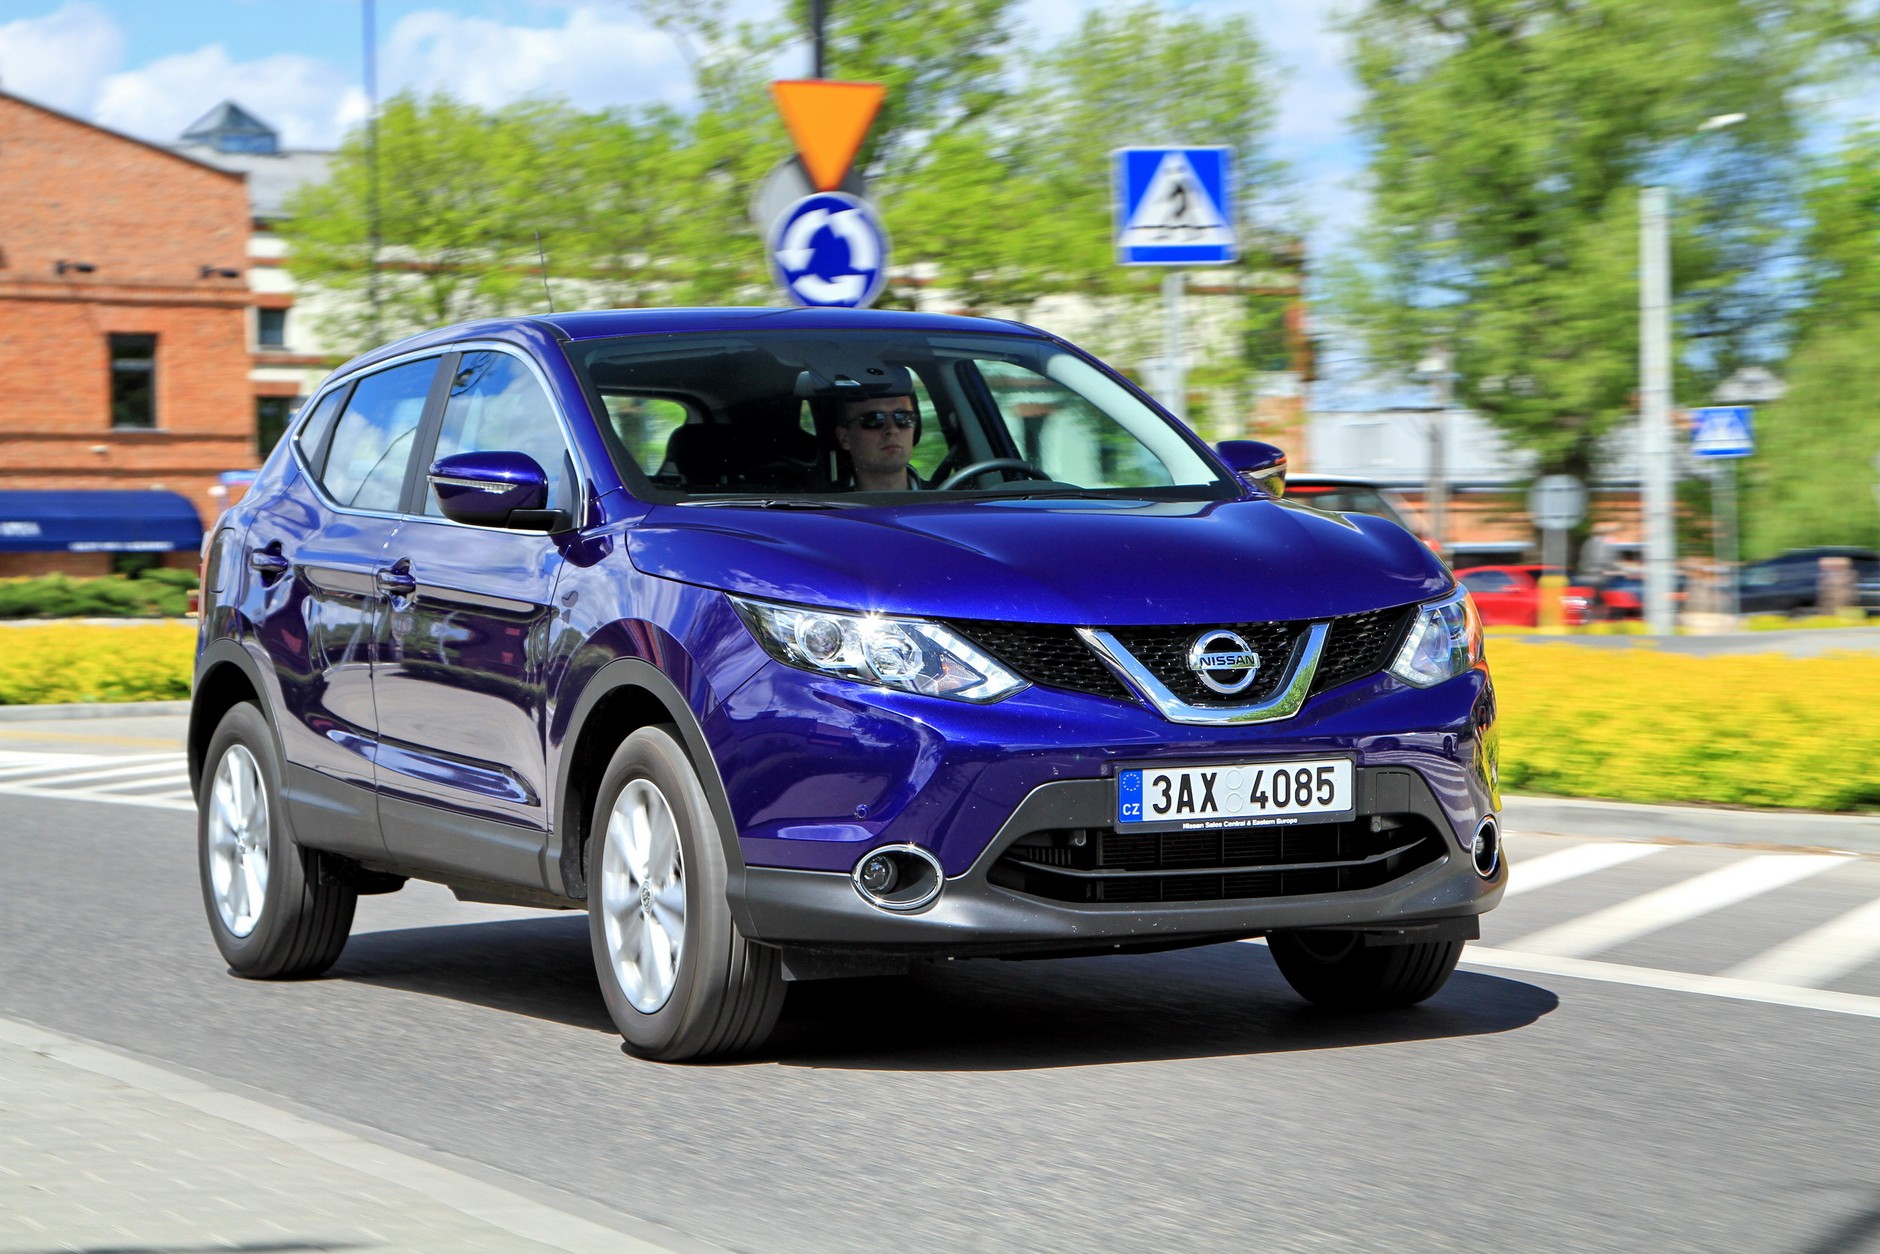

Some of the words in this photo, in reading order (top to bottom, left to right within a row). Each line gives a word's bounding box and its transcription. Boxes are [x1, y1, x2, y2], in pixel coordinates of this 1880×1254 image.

[1200, 655, 1255, 666] NISSAN
[1152, 772, 1218, 814] 3AX
[1250, 766, 1335, 809] 4085
[1122, 803, 1140, 816] CZ
[1252, 818, 1275, 826] Eastern
